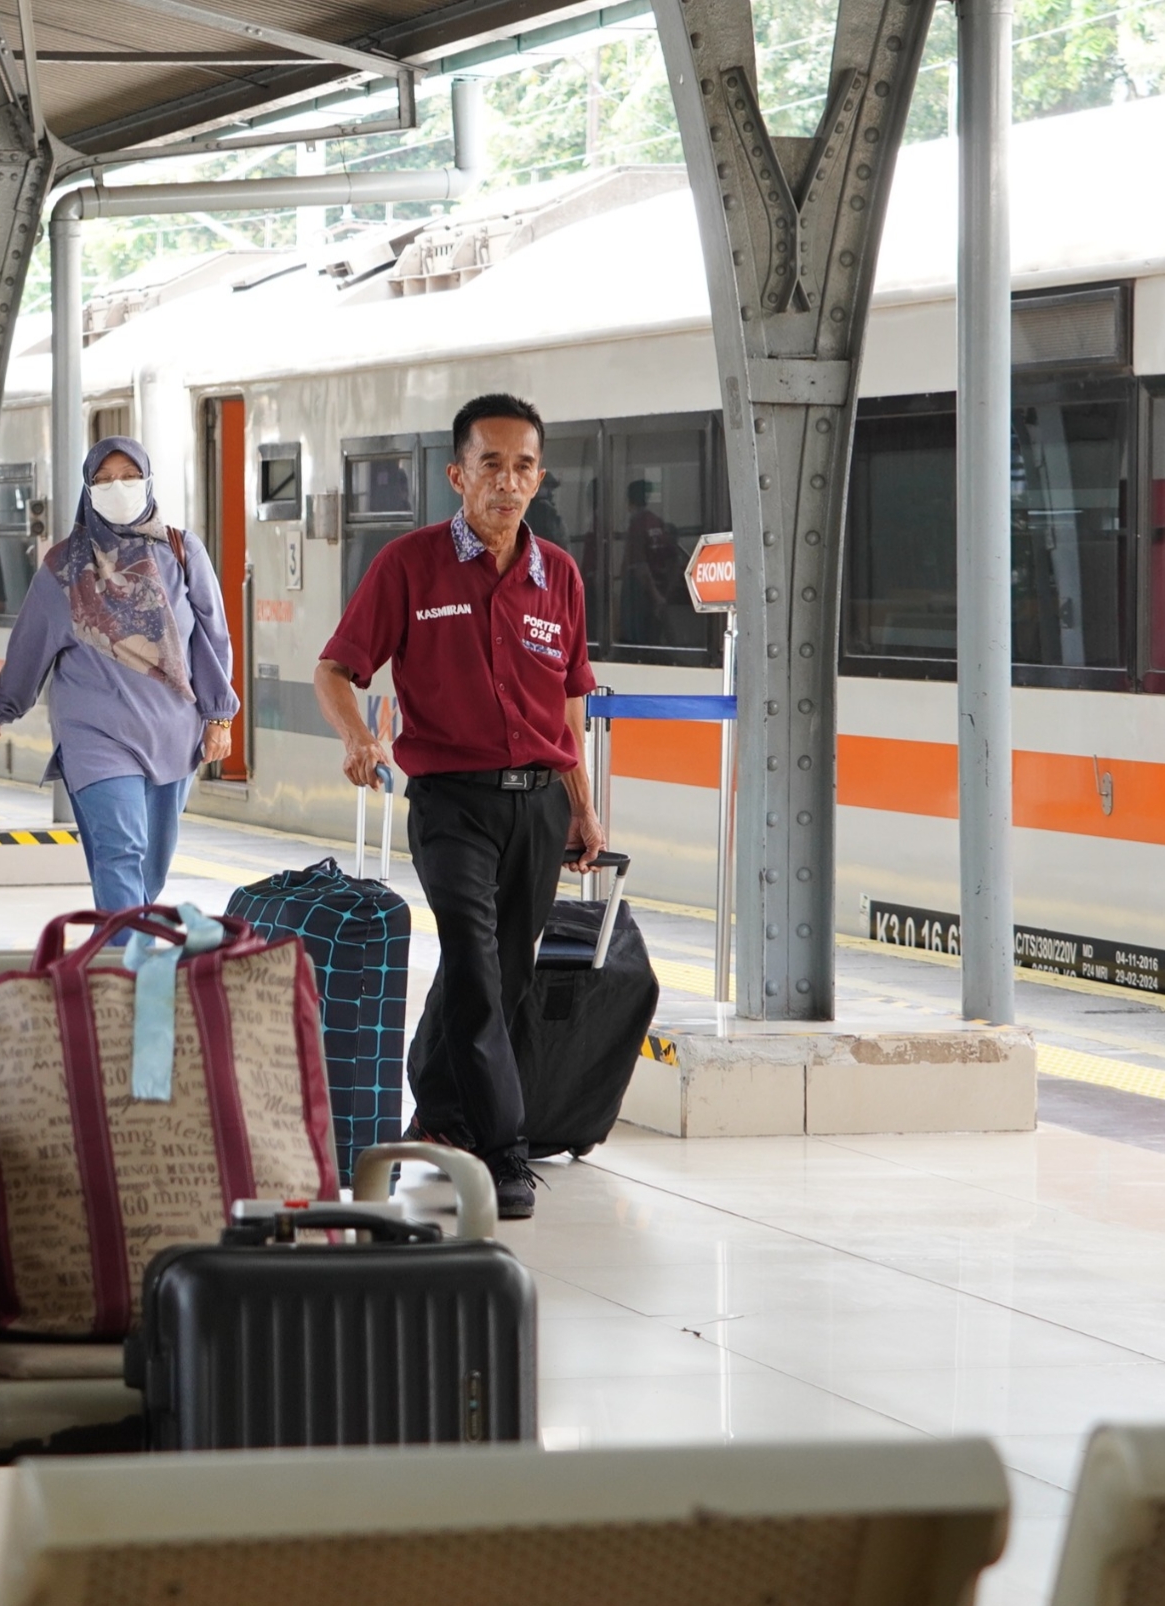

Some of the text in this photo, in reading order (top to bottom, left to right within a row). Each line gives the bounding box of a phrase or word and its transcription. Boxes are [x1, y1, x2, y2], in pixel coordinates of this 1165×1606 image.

[290, 543, 297, 575] 3
[696, 561, 735, 583] EKONO
[415, 603, 472, 621] KASMIRAN
[523, 614, 562, 635] PORTER
[530, 627, 553, 643] 028
[947, 924, 963, 956] 6
[1014, 931, 1077, 965] C/TS/380/220V
[1115, 950, 1159, 972] 04-11-2016
[1115, 969, 1159, 991] 29-02-2024
[38, 1143, 73, 1161] MEN
[161, 1143, 199, 1158] MNG
[167, 1163, 217, 1175] MENGO
